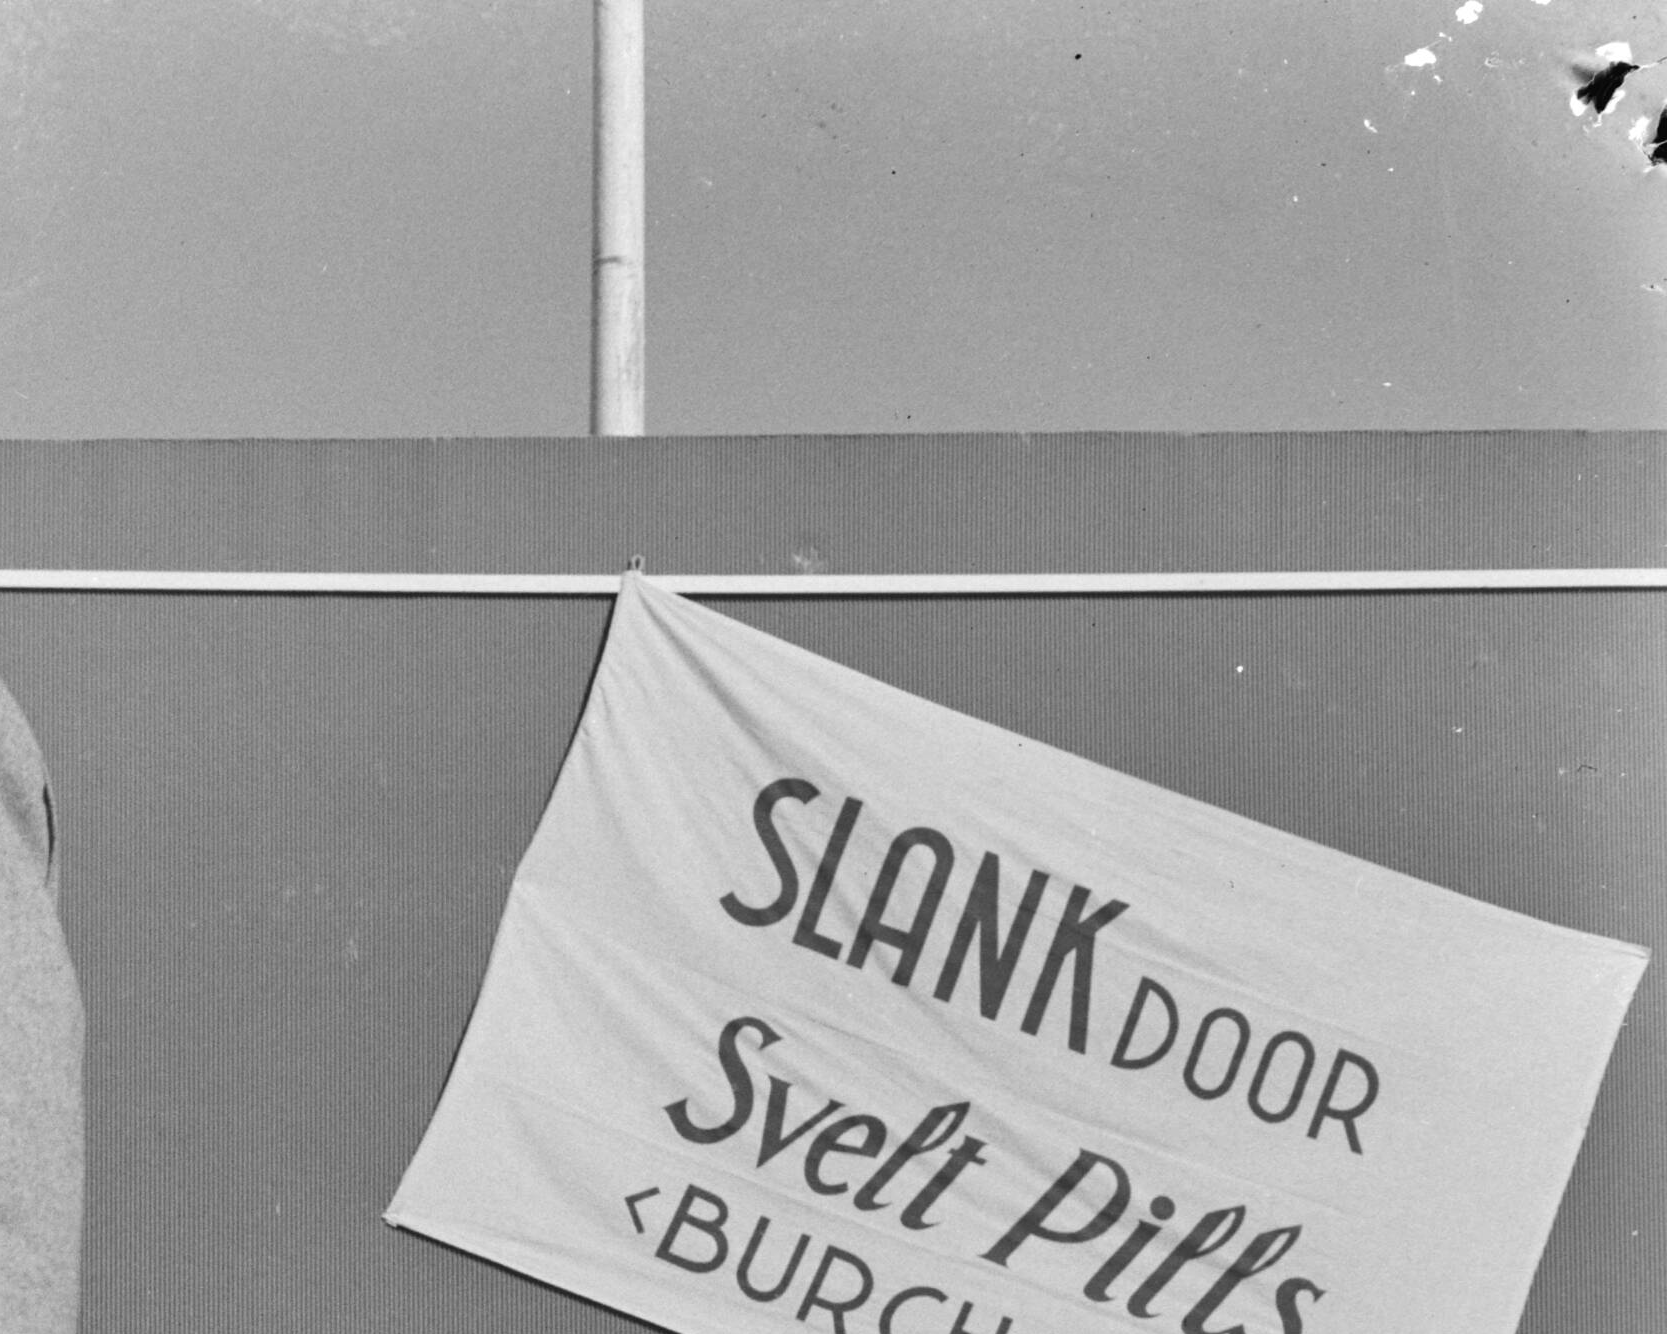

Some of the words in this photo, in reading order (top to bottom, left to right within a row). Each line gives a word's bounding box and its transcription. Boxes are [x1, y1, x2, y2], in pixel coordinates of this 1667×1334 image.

[718, 777, 1130, 1055] SLANK
[1110, 976, 1381, 1155] DOOR
[663, 1015, 985, 1231] Svelt
